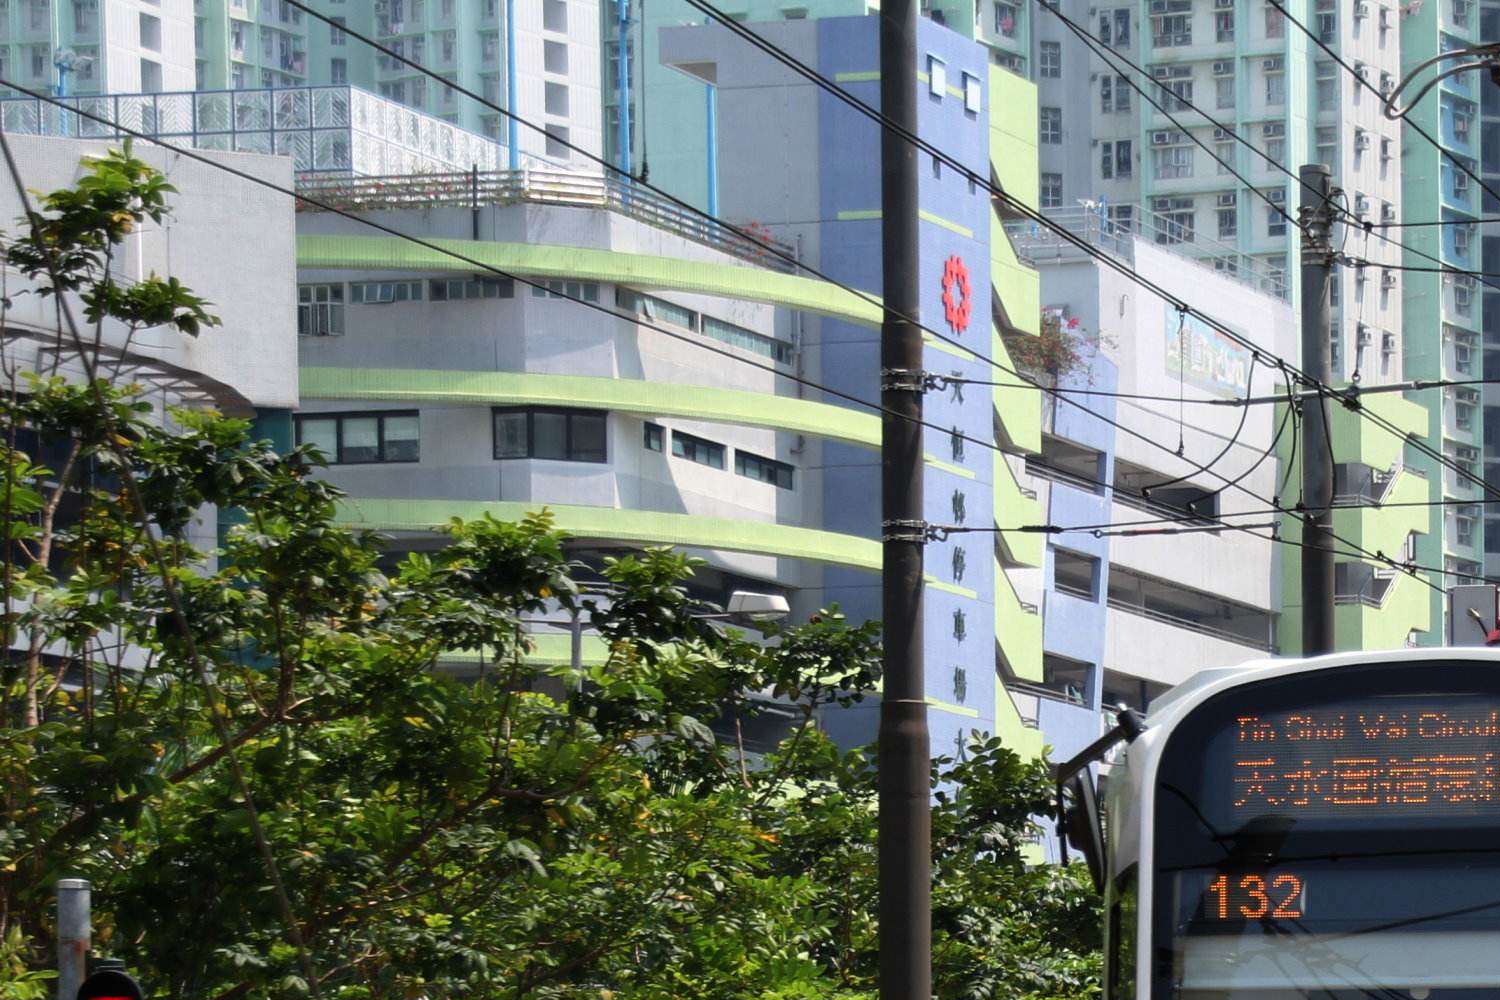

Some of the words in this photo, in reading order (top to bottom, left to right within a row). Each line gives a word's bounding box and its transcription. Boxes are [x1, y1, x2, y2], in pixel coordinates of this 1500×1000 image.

[1236, 717, 1275, 741] Tin
[1285, 715, 1345, 740] Shui
[1359, 714, 1408, 739] Wai
[1209, 875, 1301, 918] 132
